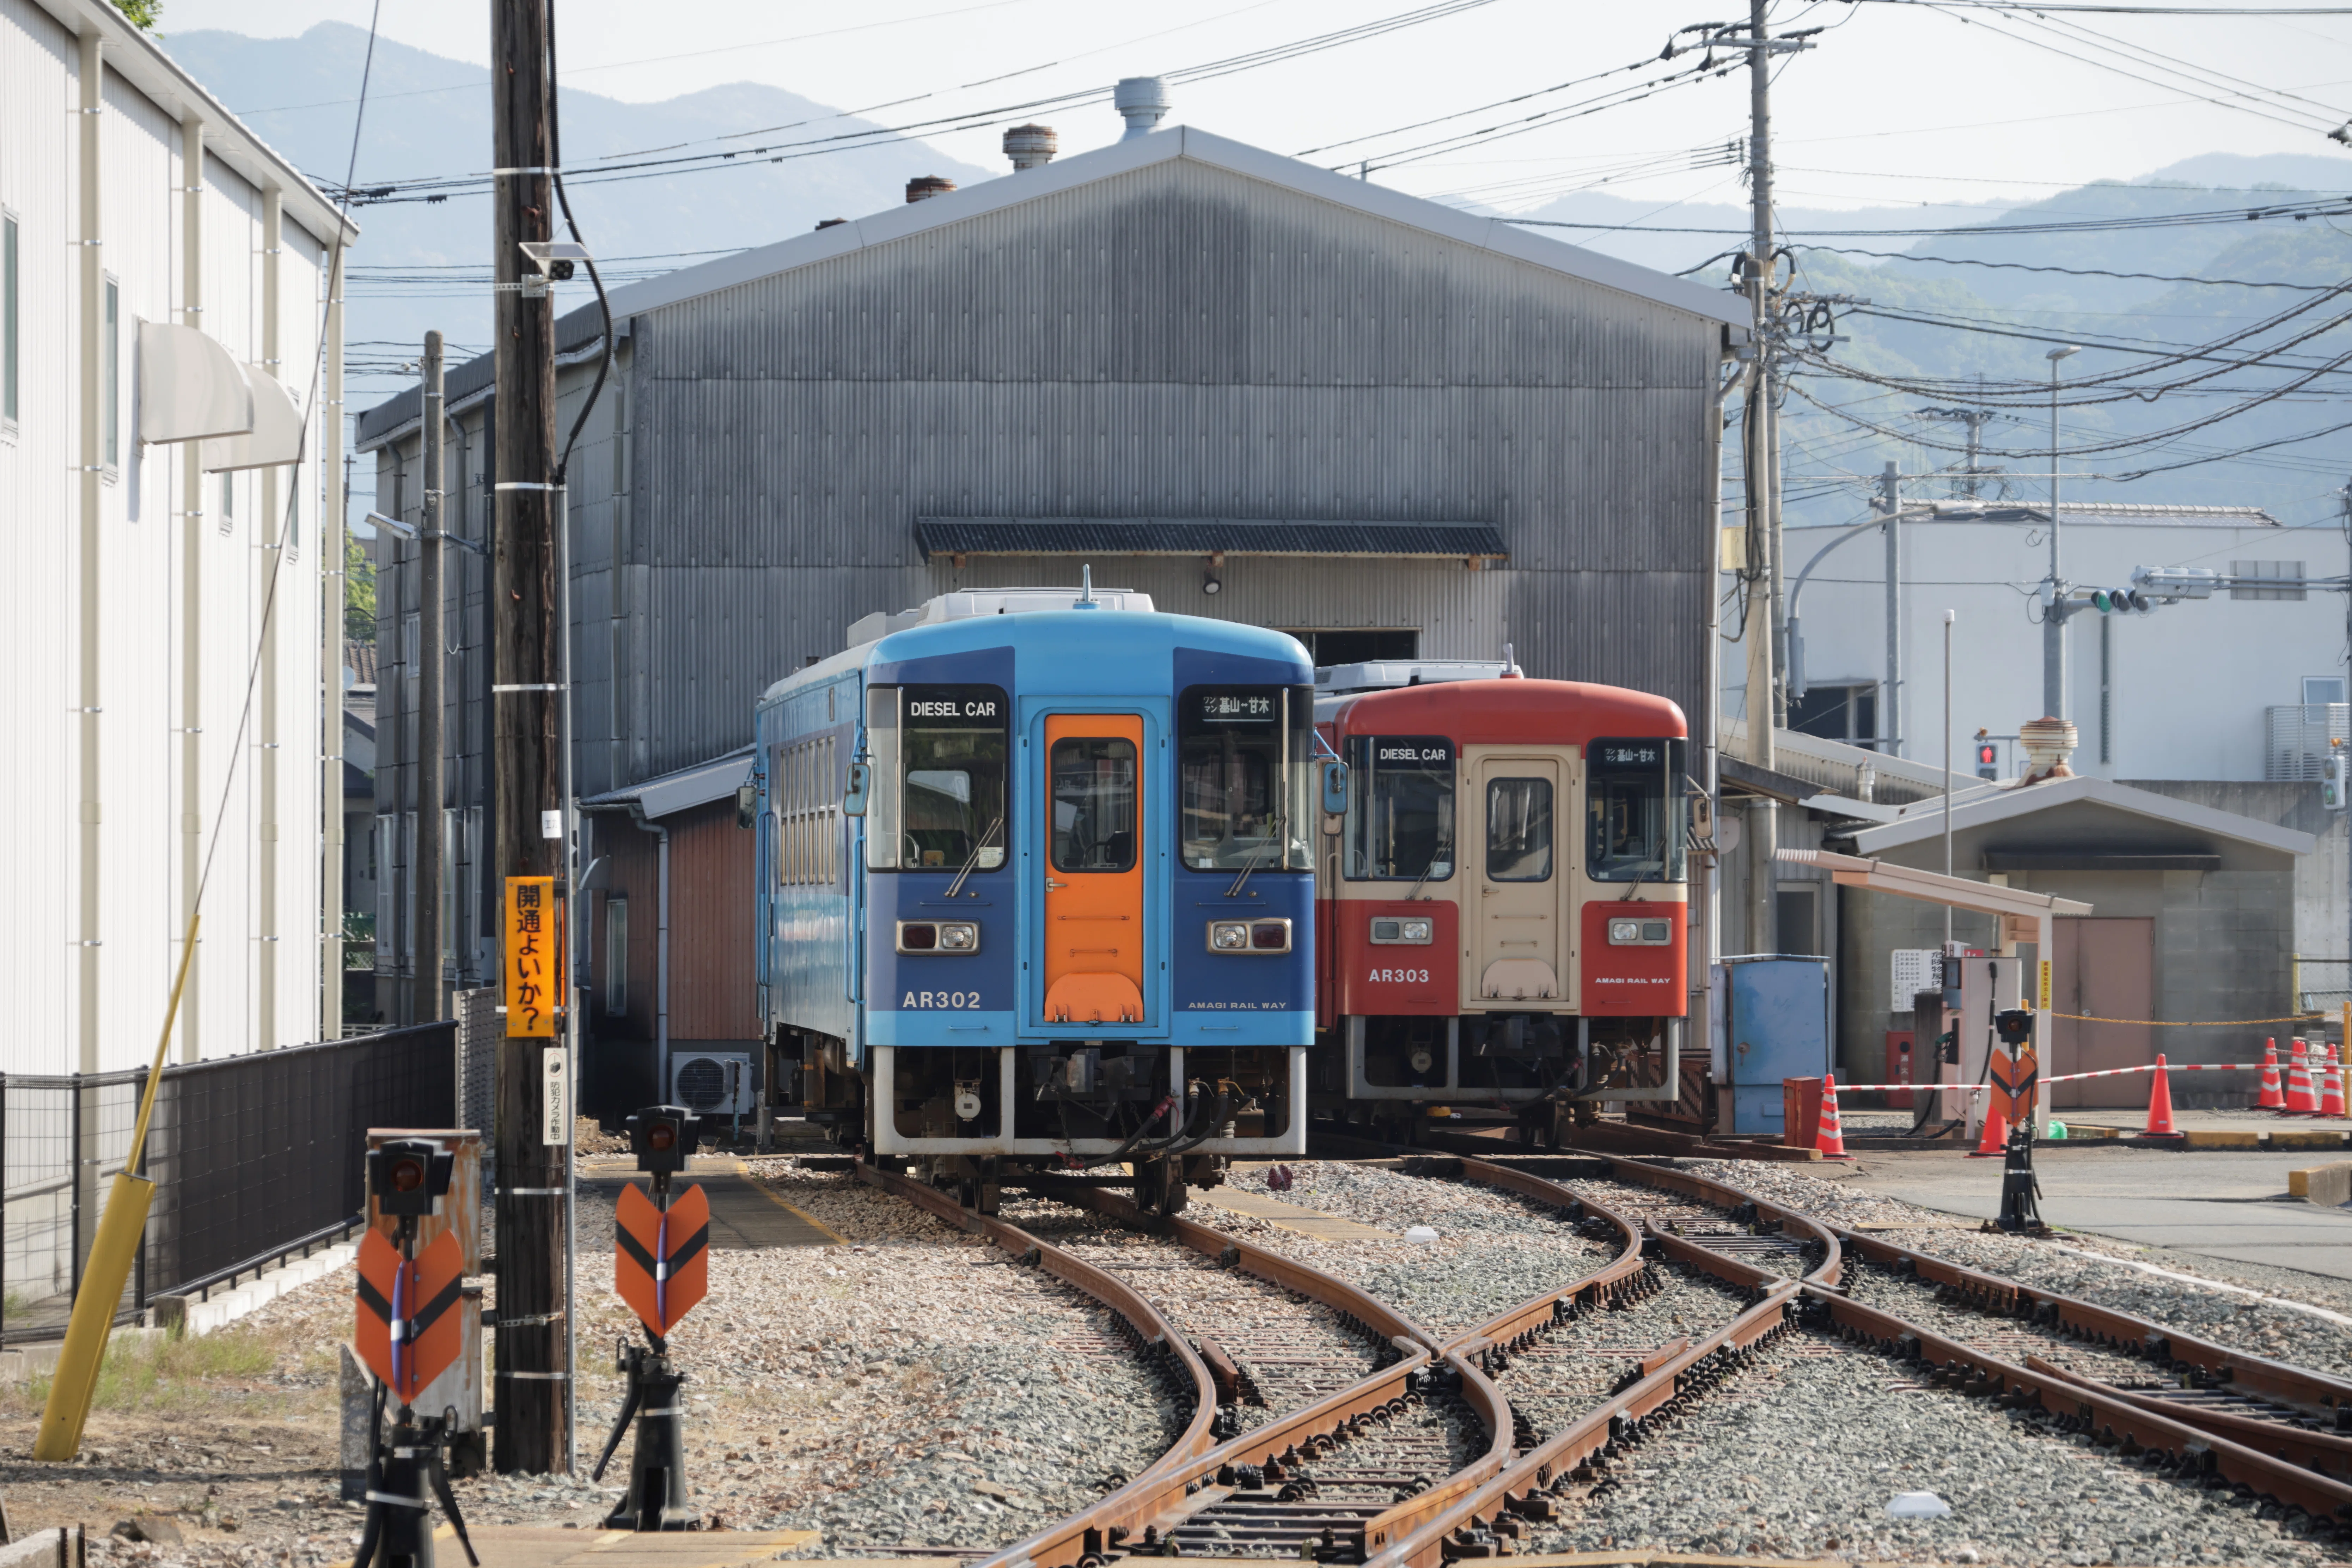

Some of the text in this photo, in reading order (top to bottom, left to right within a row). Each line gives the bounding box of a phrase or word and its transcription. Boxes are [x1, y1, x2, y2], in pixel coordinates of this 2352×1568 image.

[911, 702, 995, 716] DIESEL CAR
[1219, 696, 1269, 714] 基山 甘木
[1380, 748, 1446, 760] DIESEL CAR
[1617, 748, 1655, 762] 基山 甘木
[516, 884, 542, 1031] 開通よいか?
[1369, 969, 1429, 983] AR303
[903, 991, 980, 1008] AR302
[550, 1081, 560, 1141] 防犯カメラ作動中
